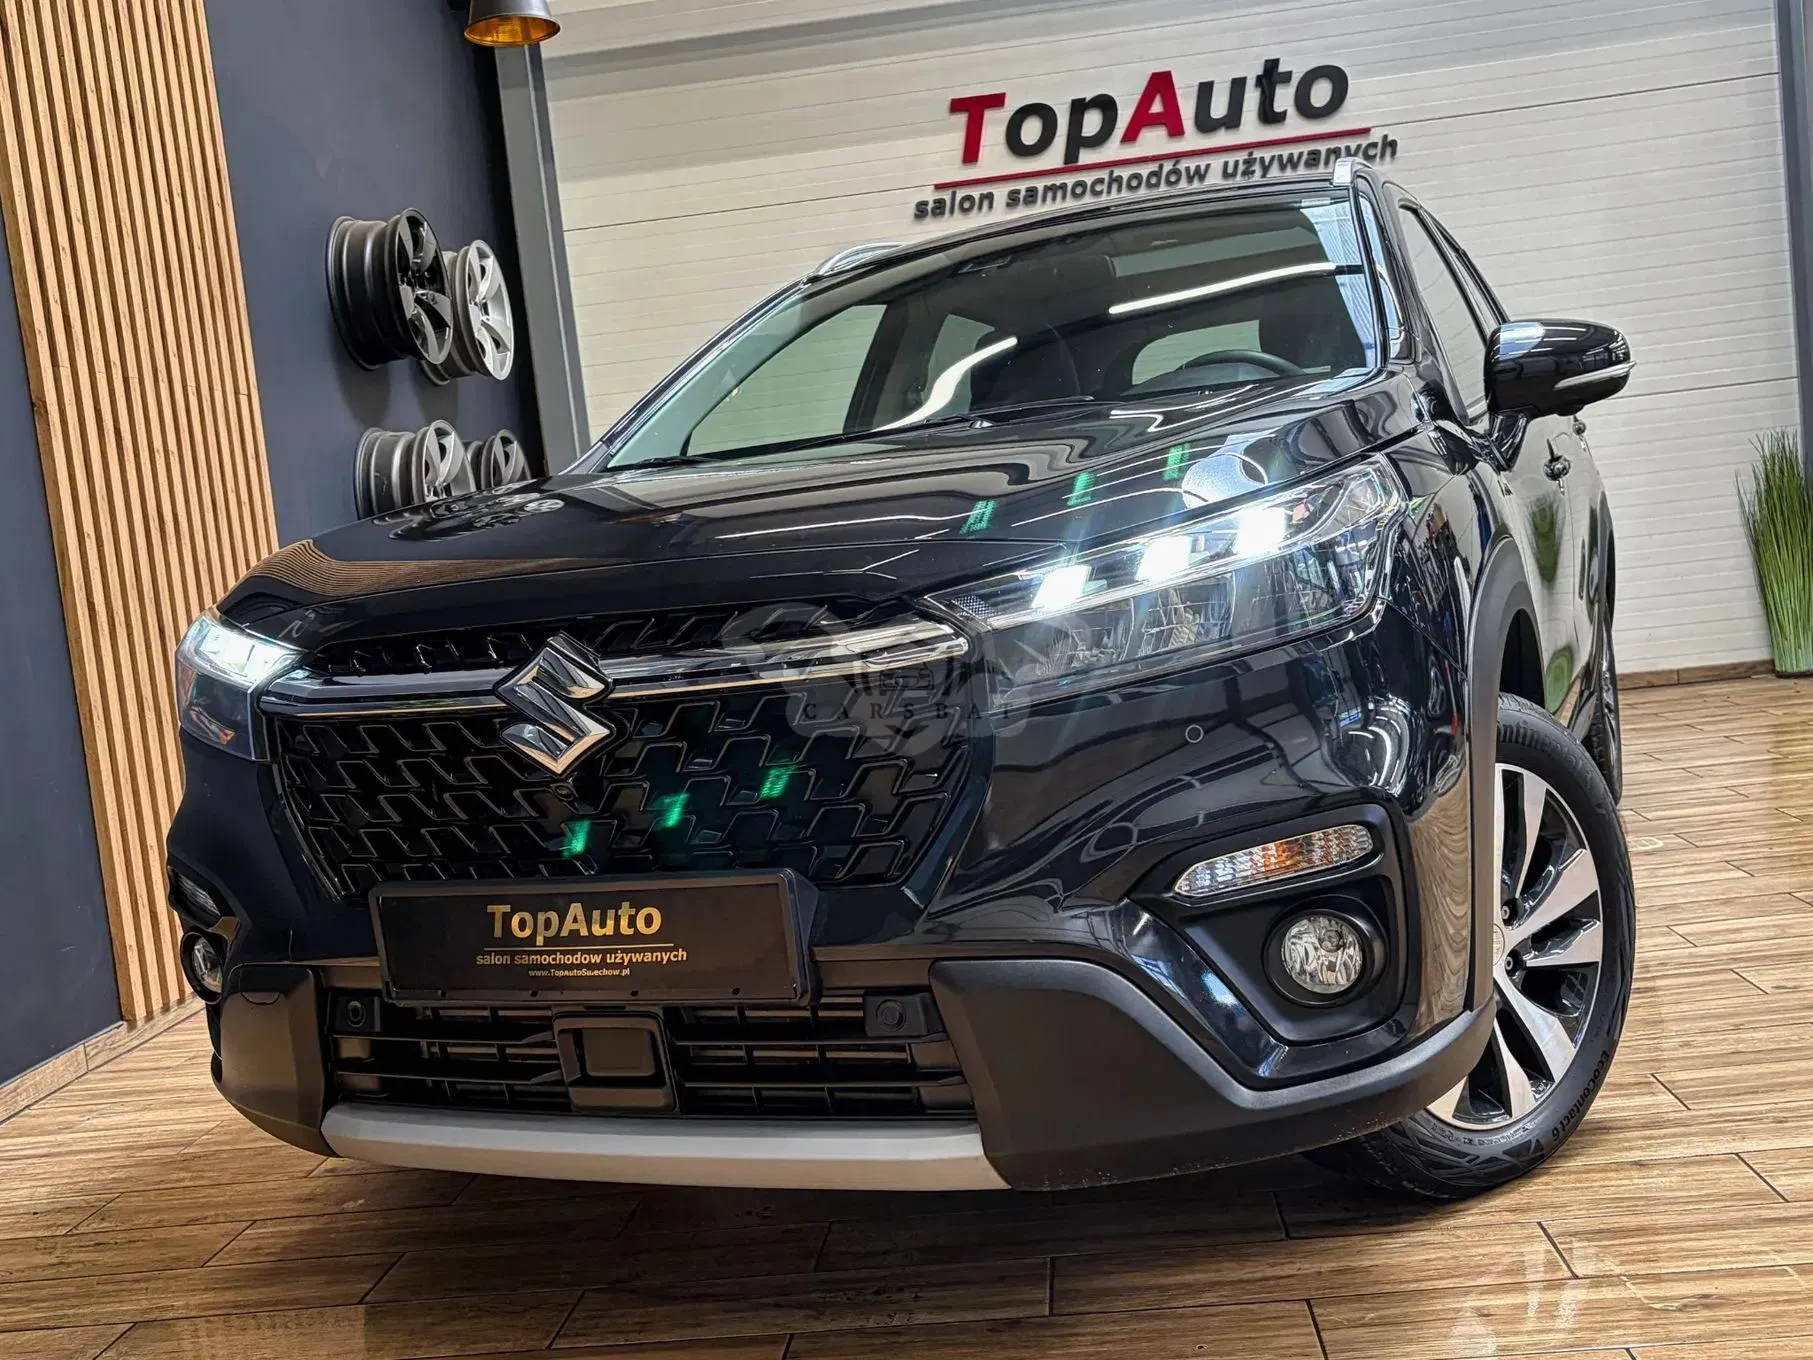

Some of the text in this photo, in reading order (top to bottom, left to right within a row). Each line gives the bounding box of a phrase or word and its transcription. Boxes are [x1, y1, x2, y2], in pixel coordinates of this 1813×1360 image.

[949, 58, 1349, 165] TopAuto
[914, 134, 1398, 219] salon samochodów używanych
[487, 902, 662, 946] TopAuto
[476, 952, 511, 965] salon
[606, 948, 687, 968] używanych
